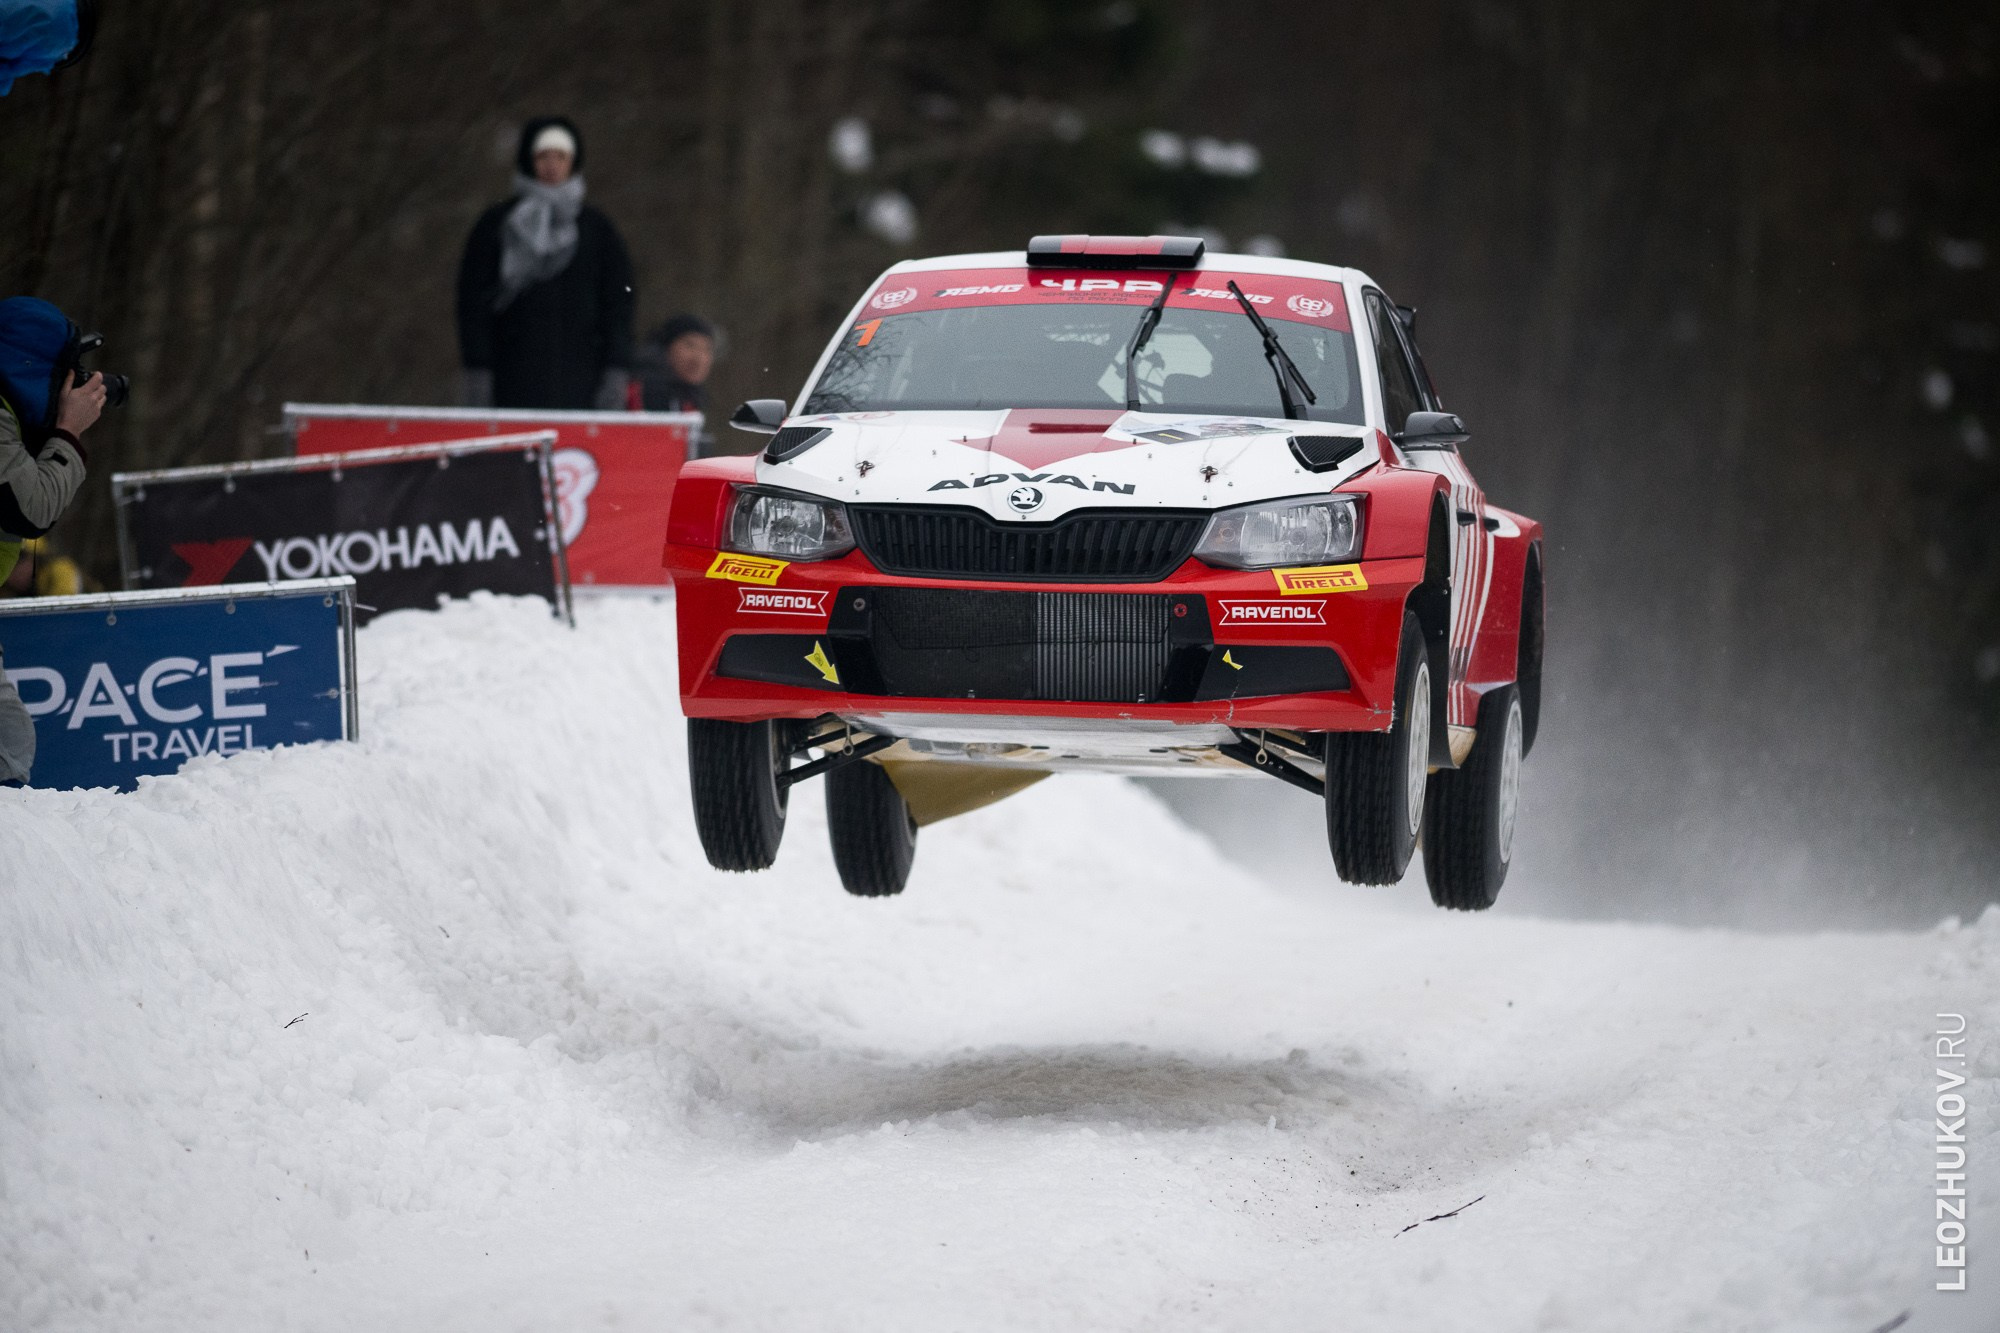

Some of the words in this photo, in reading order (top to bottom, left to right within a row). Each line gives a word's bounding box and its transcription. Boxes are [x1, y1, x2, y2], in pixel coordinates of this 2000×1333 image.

[937, 284, 1025, 298] ASMG
[854, 318, 883, 347] 1
[926, 472, 1137, 495] ADVAN
[254, 516, 521, 582] YOKOHAMA
[714, 558, 781, 579] PIRELLI
[1281, 571, 1358, 590] PIRELLI
[745, 594, 817, 609] RAVENOL
[1231, 606, 1317, 619] RAVENOL
[103, 724, 267, 763] TRAVEL
